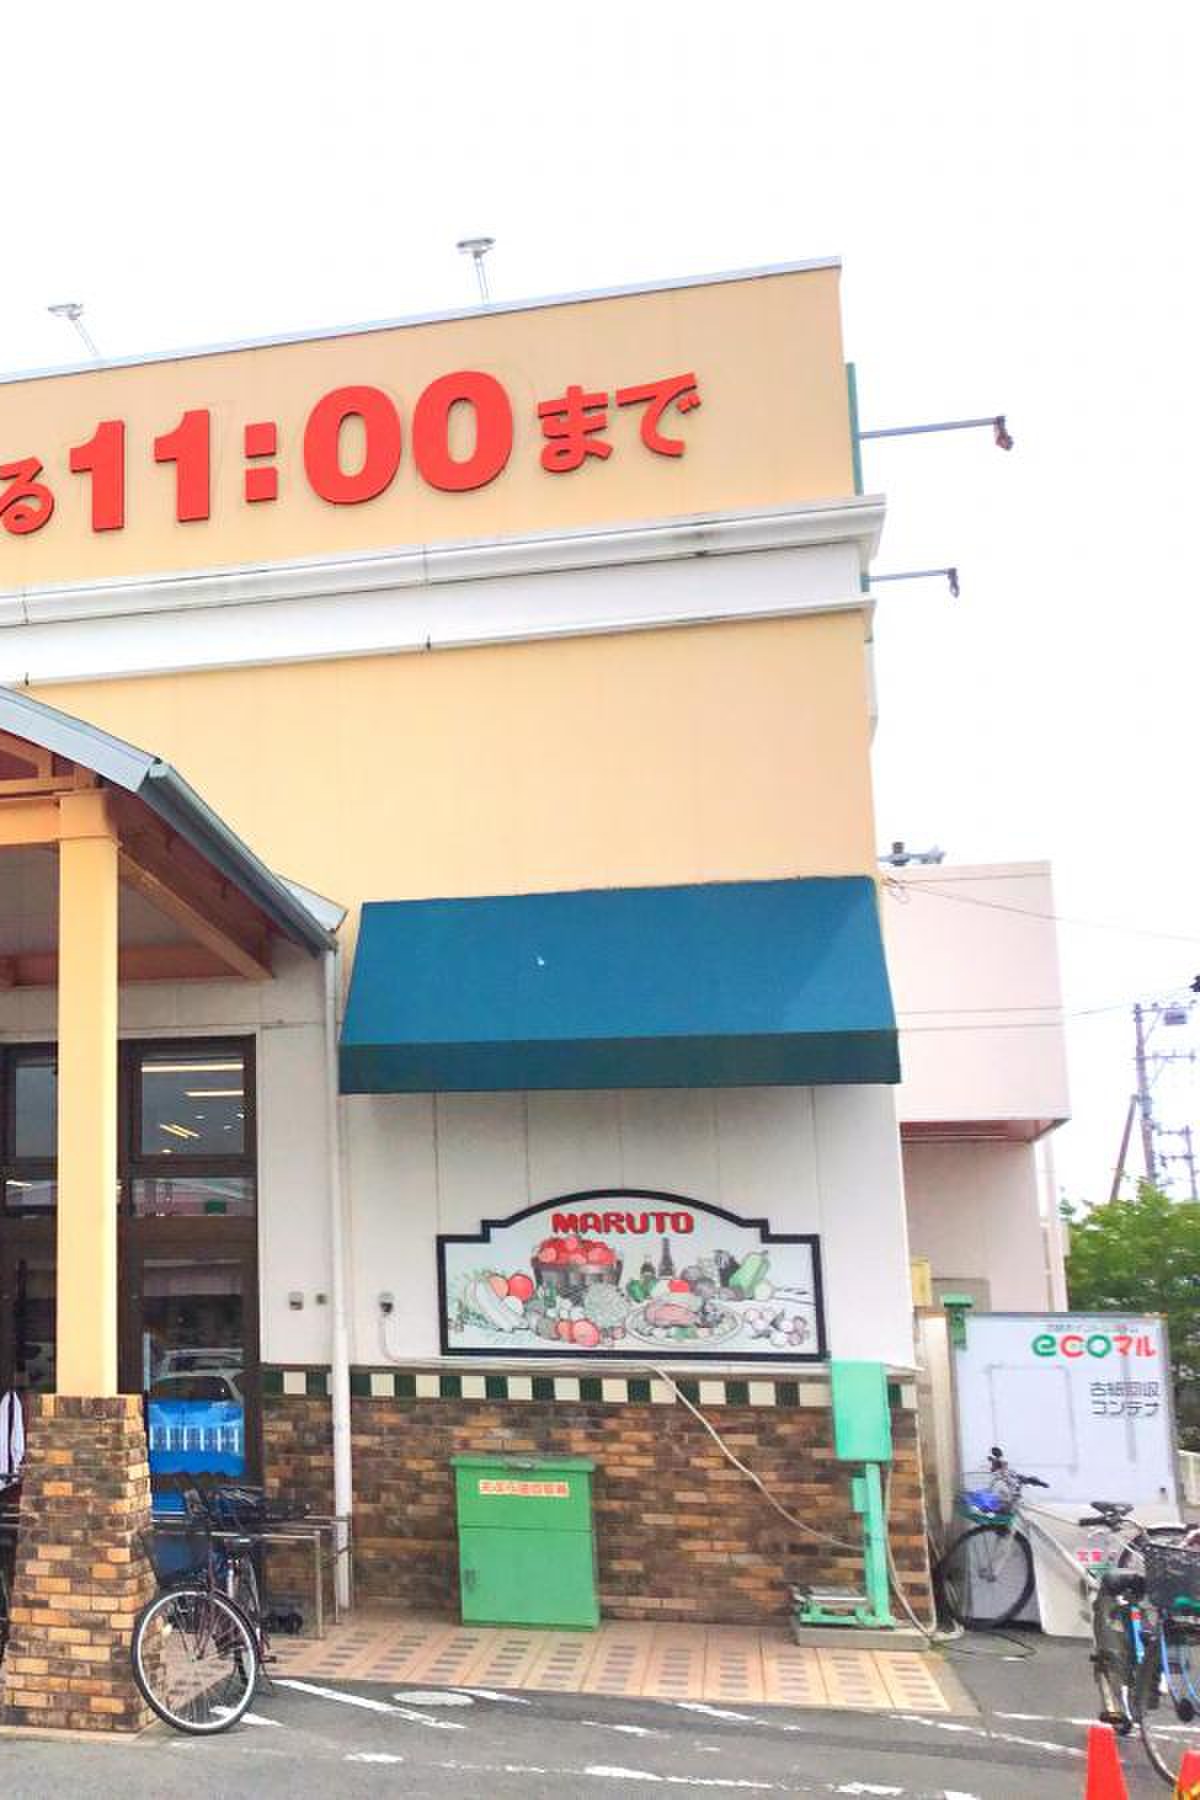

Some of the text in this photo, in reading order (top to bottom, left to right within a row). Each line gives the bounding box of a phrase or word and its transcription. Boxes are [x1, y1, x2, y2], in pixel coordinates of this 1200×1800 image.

[551, 1211, 695, 1235] MARUTO
[1090, 1400, 1160, 1417] コンテナ
